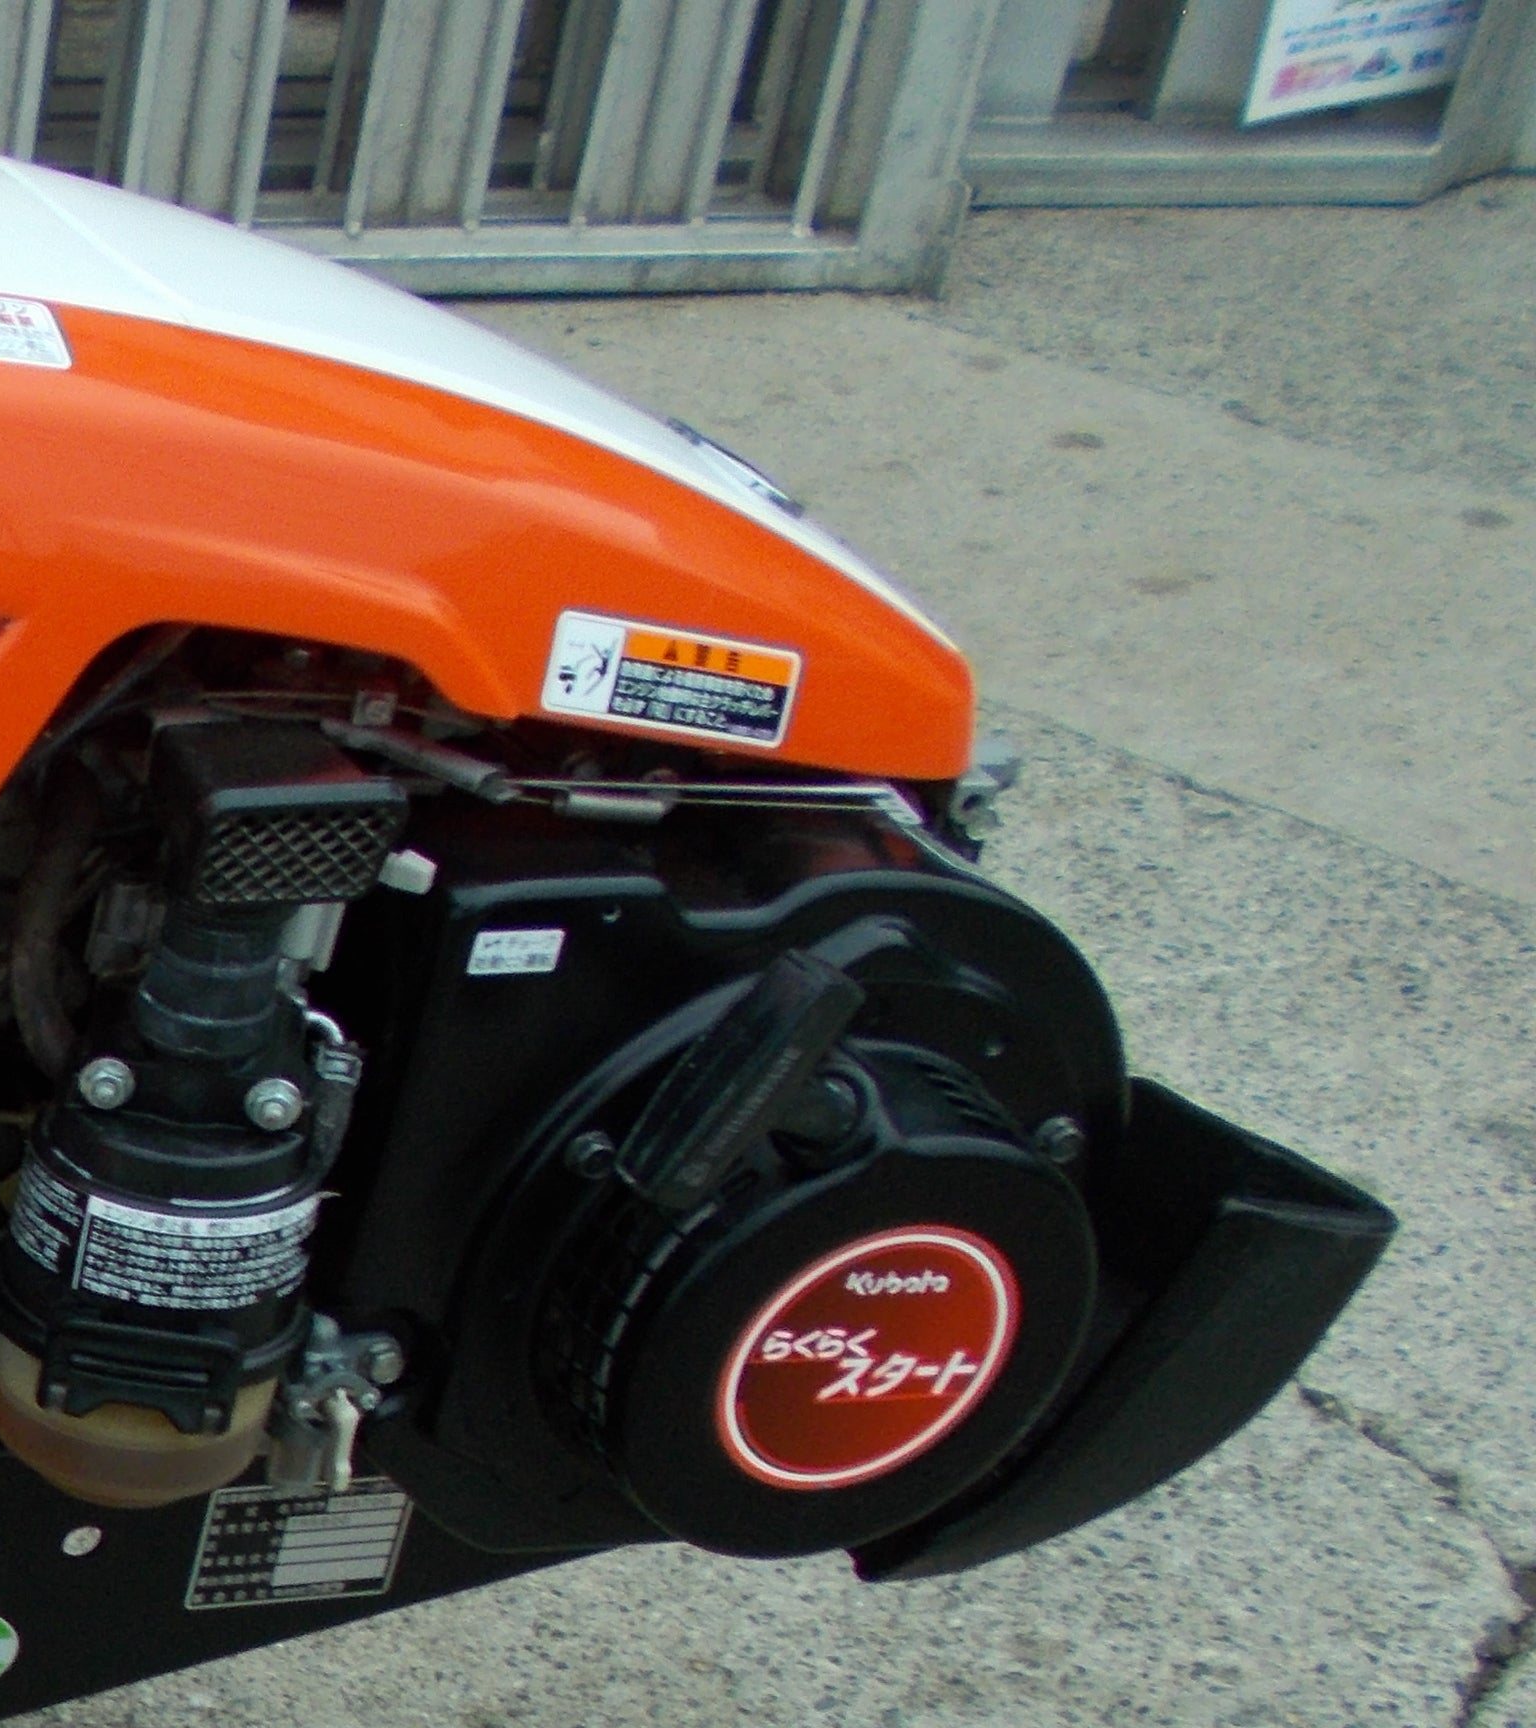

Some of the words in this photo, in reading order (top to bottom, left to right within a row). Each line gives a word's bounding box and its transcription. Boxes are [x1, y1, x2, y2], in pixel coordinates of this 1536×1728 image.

[845, 1269, 950, 1296] Kubota
[762, 1328, 878, 1361] らくらく
[815, 1351, 978, 1399] スタート
